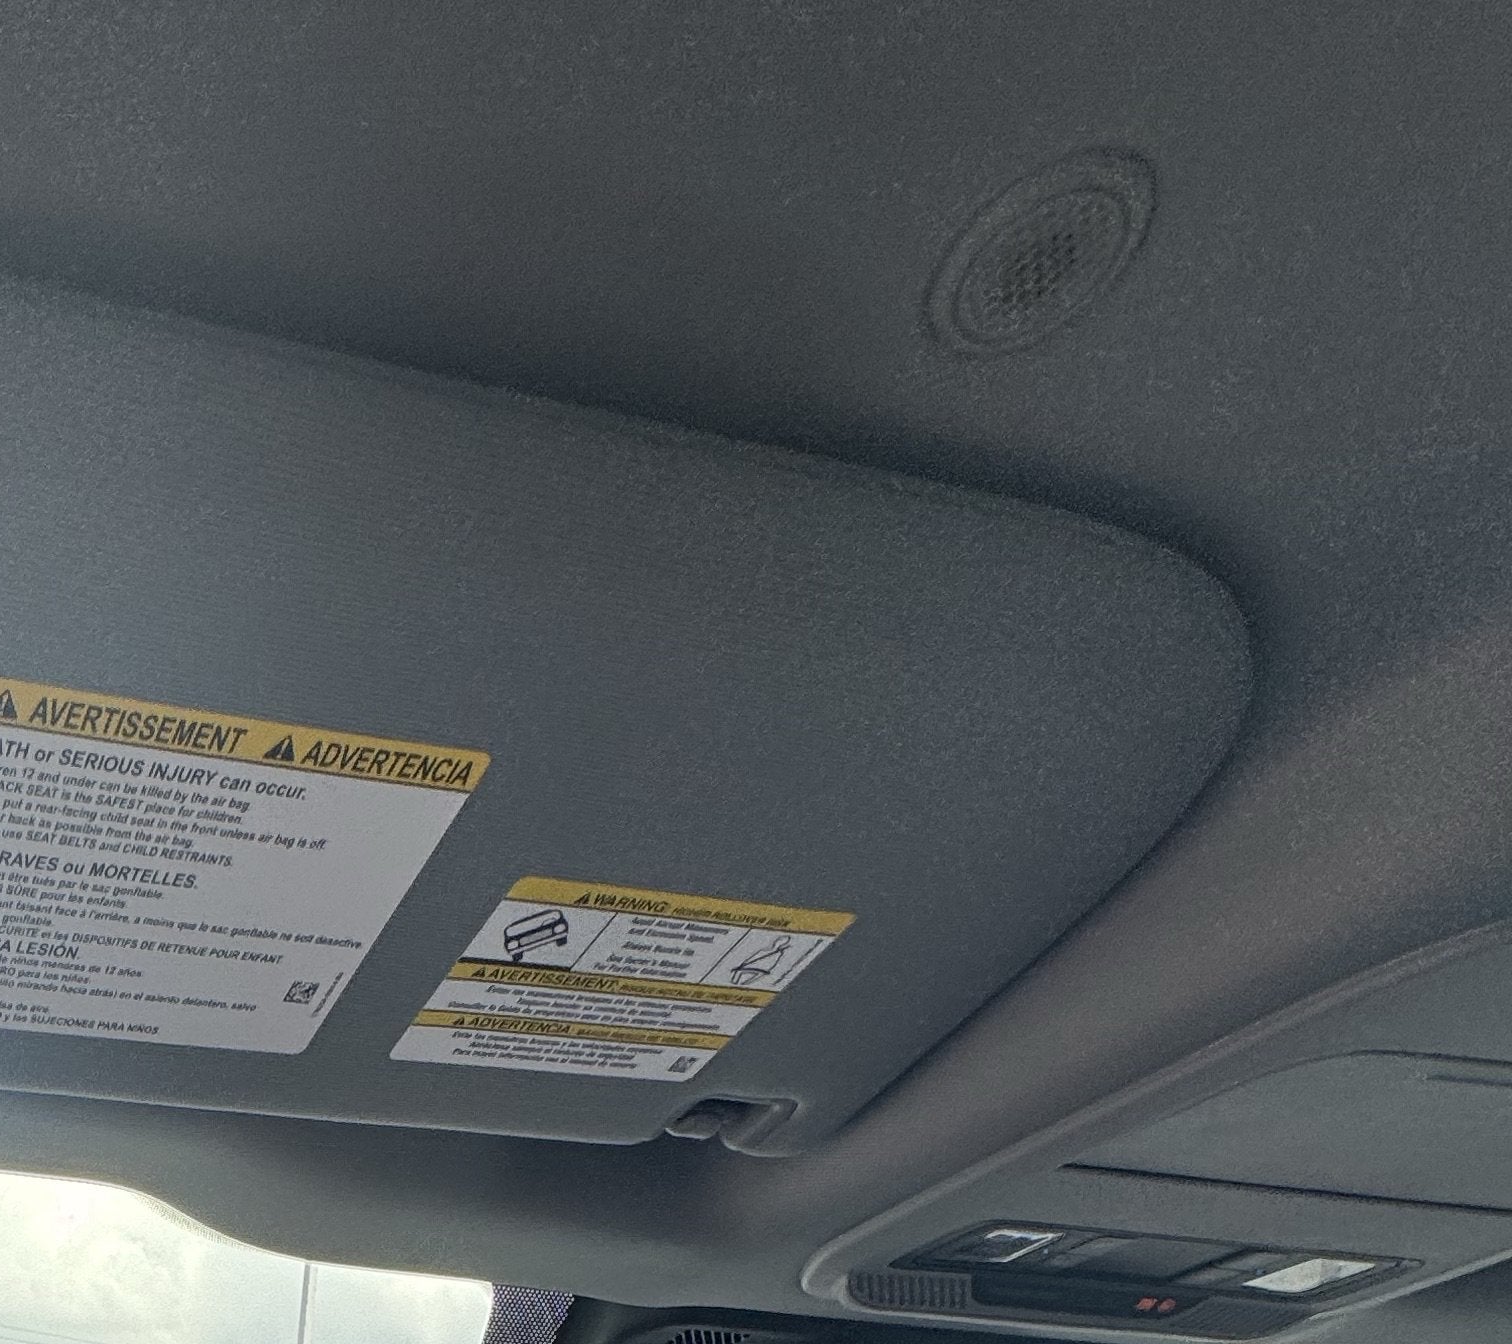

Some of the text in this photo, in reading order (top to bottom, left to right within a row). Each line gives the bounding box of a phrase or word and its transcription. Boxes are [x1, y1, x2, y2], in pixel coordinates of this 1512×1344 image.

[28, 695, 248, 754] AVERTISSEMENT
[35, 748, 54, 763] or
[59, 749, 144, 776] SERIOUS
[149, 762, 218, 786] INJURY
[219, 776, 251, 792] can
[255, 781, 306, 800] occur.
[300, 741, 474, 785] ADVERTENCIA
[22, 768, 34, 779] 12
[37, 770, 61, 783] and
[63, 774, 96, 789] under
[100, 781, 120, 791] can
[124, 783, 137, 794] be
[141, 785, 171, 799] killed
[175, 790, 188, 803] by
[191, 792, 208, 804] the
[211, 796, 224, 806] air
[26, 785, 58, 797] SEAT
[61, 790, 72, 799] is
[74, 790, 93, 802] the
[96, 794, 144, 811] SAFEST
[144, 802, 175, 816] place
[178, 805, 194, 816] for
[3, 799, 23, 810] put
[35, 803, 97, 821] rear-facing
[100, 810, 129, 825] child
[131, 815, 155, 827] seat
[157, 818, 168, 827] in
[170, 821, 188, 832] the
[190, 823, 217, 836] front
[220, 828, 255, 841] unless
[258, 833, 272, 843] air
[275, 834, 295, 849] bag
[297, 839, 306, 847] is
[38, 819, 51, 829] as
[54, 821, 103, 837] possible
[106, 827, 132, 839] from
[135, 830, 151, 842] the
[155, 833, 170, 844] air
[2, 828, 23, 840] use
[26, 830, 56, 845] SEAT
[59, 835, 96, 850] BELTS
[99, 839, 120, 852] and
[122, 843, 157, 857] CHILD
[63, 862, 85, 875] ou
[88, 862, 198, 889] MORTELLES.
[594, 893, 668, 913] WARNING
[489, 970, 618, 990] AVERTISSEMENT
[470, 1017, 571, 1034] ADVERTENCIA
